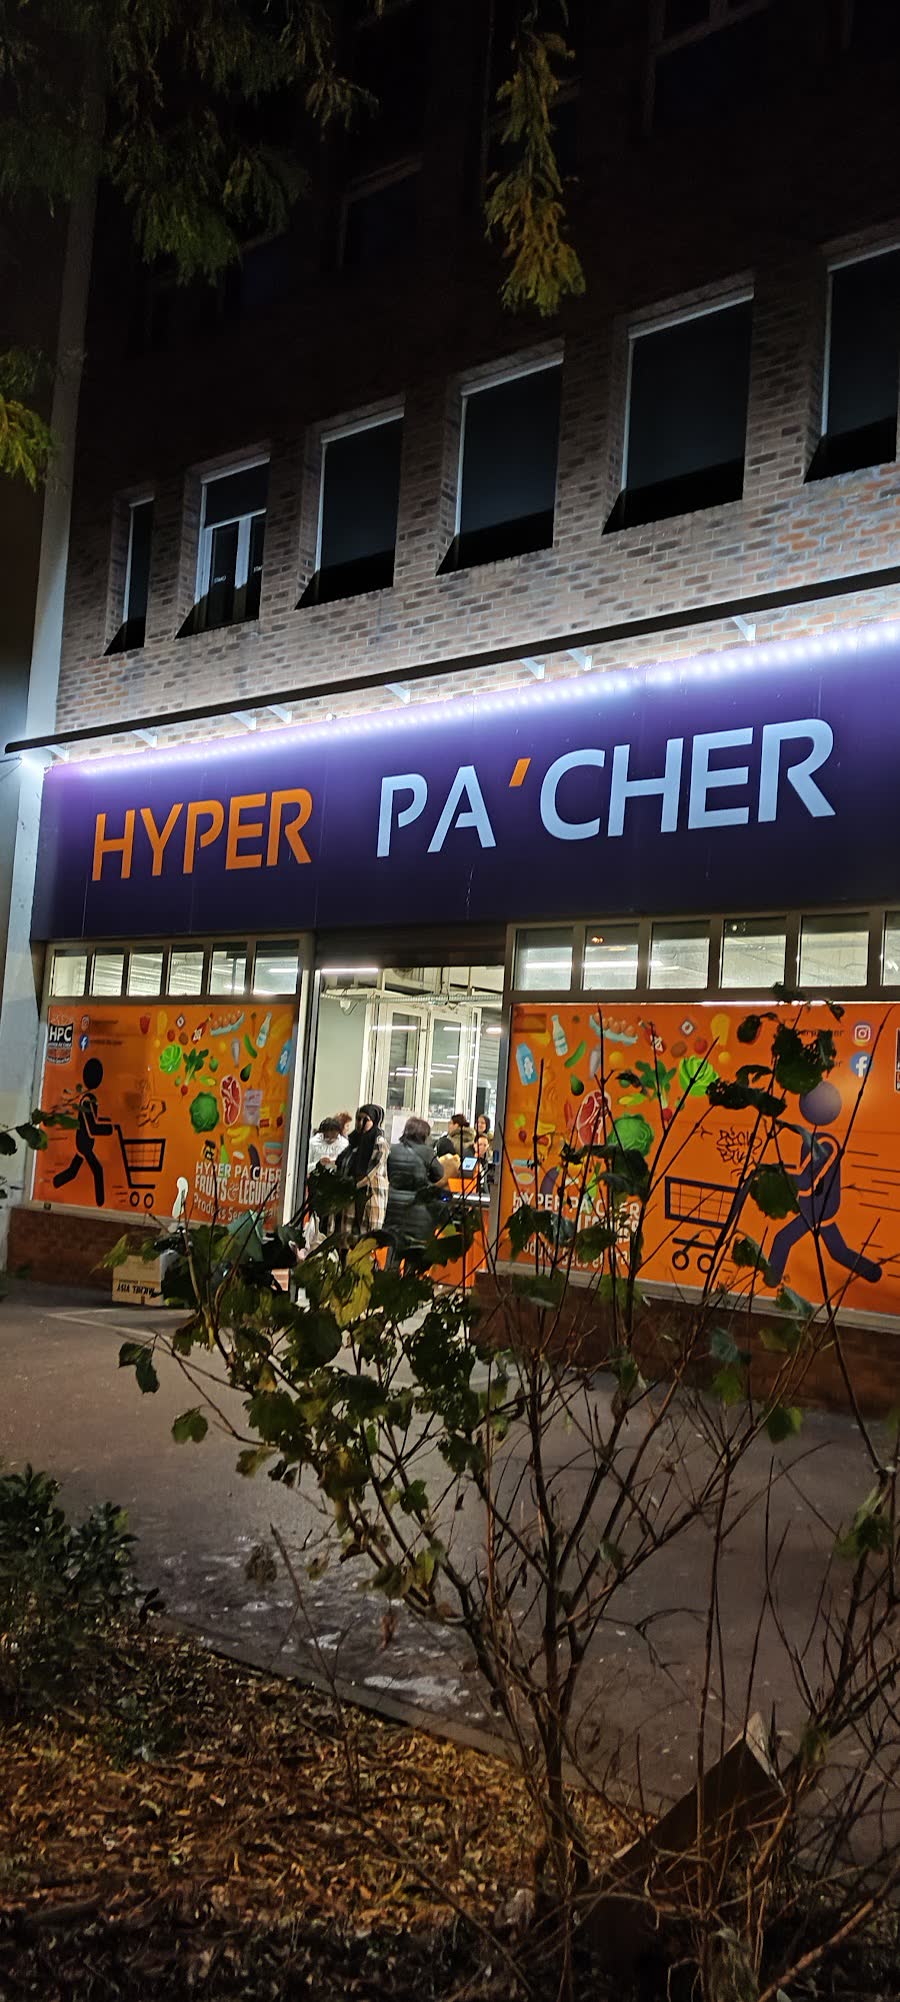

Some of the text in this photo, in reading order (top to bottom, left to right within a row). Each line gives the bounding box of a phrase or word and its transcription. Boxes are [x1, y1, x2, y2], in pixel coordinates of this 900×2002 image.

[91, 718, 836, 881] HYPER PA'CHER
[49, 1025, 73, 1043] HPC
[195, 1162, 232, 1178] HYPER
[194, 1193, 227, 1220] Produts
